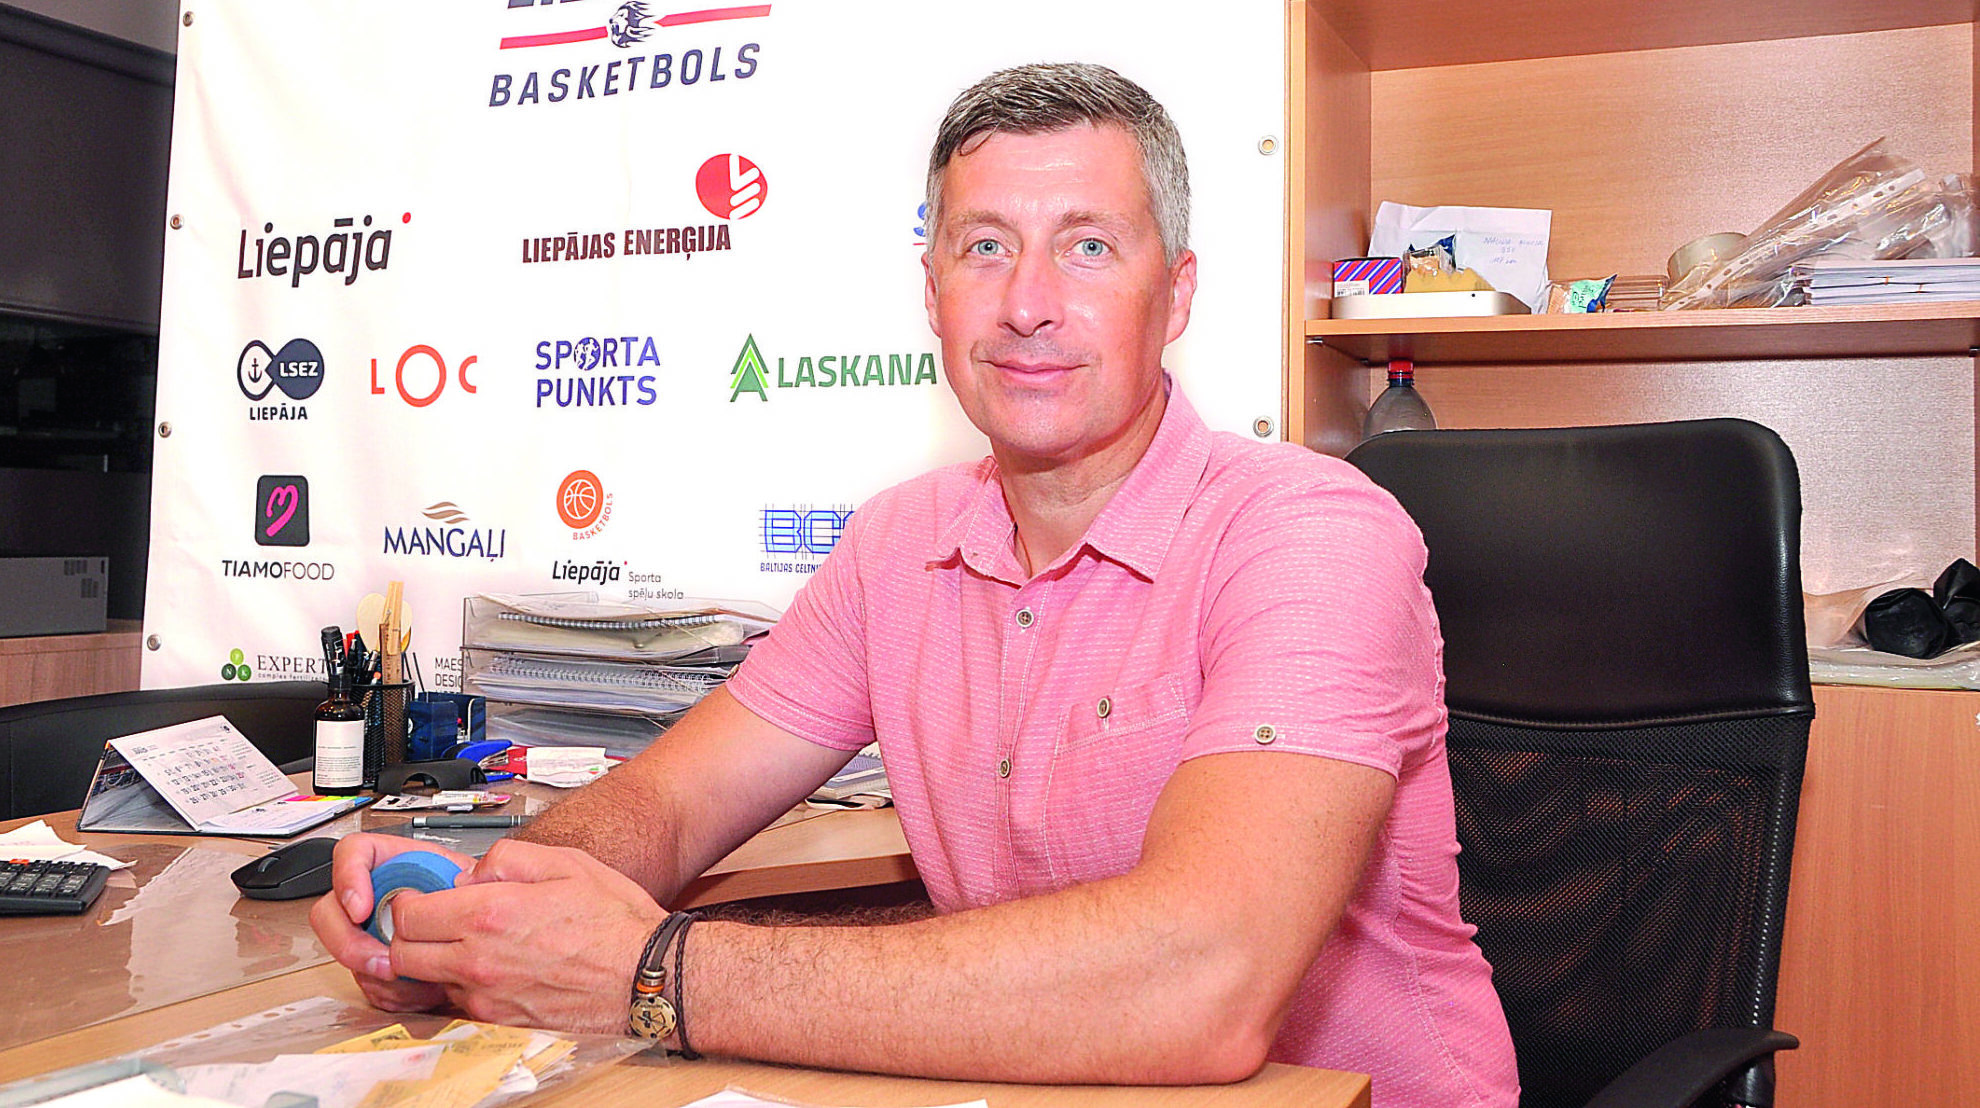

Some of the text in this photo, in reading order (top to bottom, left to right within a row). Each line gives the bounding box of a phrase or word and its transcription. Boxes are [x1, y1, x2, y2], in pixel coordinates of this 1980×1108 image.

[488, 42, 761, 108] BASKETBOLS
[237, 214, 393, 288] Liepāja
[522, 224, 732, 263] LIEPĀJAS ENERĢIJA
[279, 361, 319, 378] LSEZ
[535, 336, 661, 371] SPORTA
[777, 353, 938, 388] LASKANA
[536, 375, 657, 408] PUNKTS
[249, 402, 308, 421] LIEPĀJA
[572, 492, 614, 541] BASKETBOLS
[764, 509, 855, 554] BC
[383, 526, 506, 562] MANGAĻI
[221, 559, 335, 581] TIAMOFOOD
[552, 559, 621, 586] Liepāja
[628, 571, 662, 585] Sporta
[656, 588, 684, 600] skola
